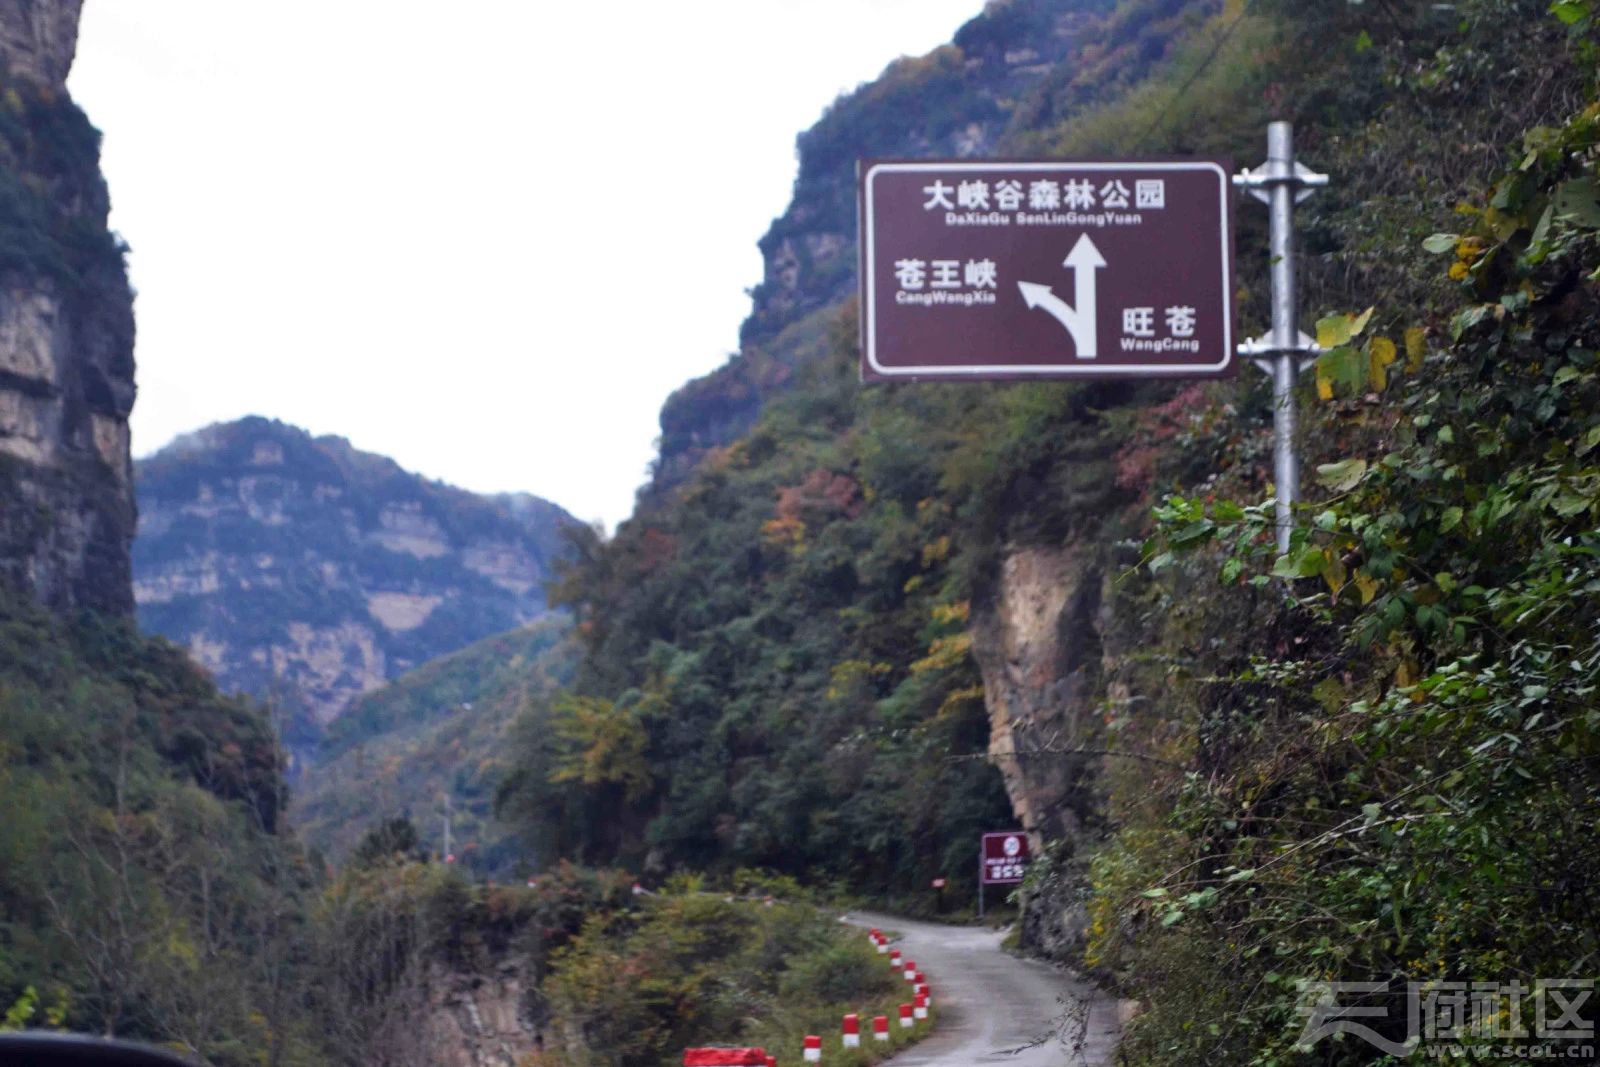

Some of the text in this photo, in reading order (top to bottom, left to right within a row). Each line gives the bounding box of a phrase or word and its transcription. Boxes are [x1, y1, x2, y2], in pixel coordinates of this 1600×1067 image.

[923, 179, 1165, 210] 大峡谷森林公园
[945, 212, 1010, 226] DaXiaGu
[895, 258, 998, 289] 苍王峡
[896, 290, 996, 305] CangWangXia
[1120, 337, 1199, 353] WangCang
